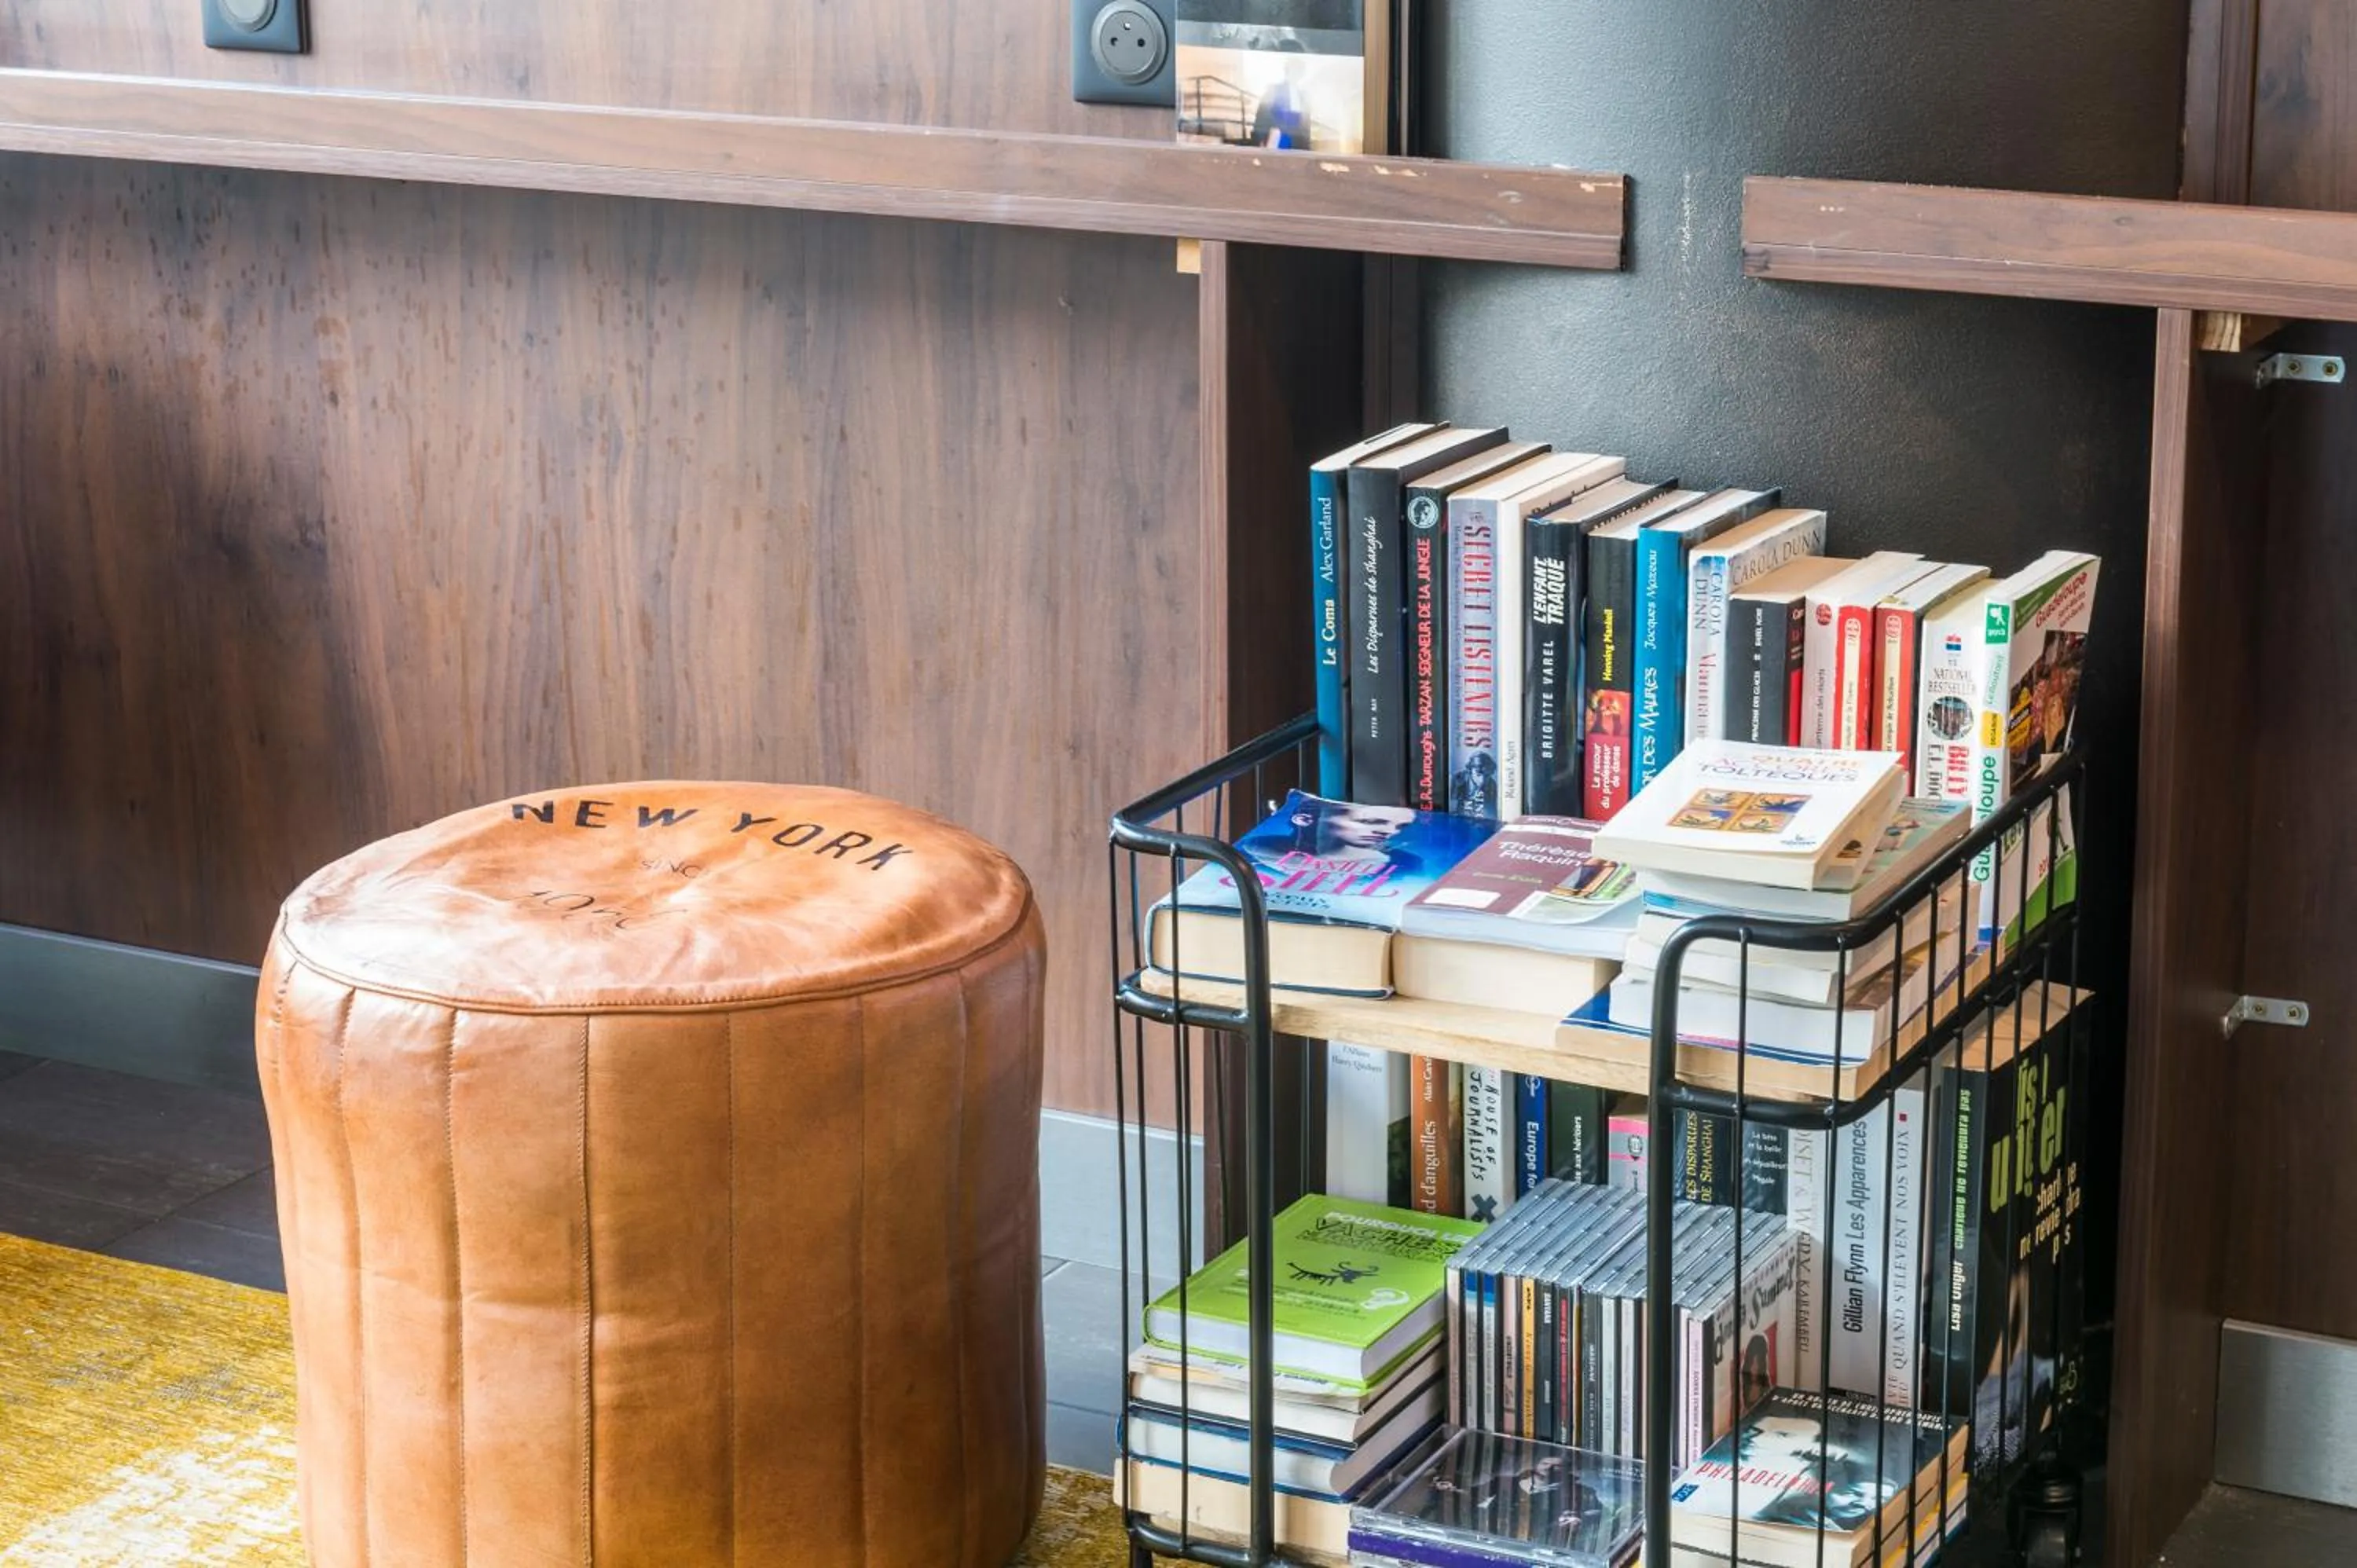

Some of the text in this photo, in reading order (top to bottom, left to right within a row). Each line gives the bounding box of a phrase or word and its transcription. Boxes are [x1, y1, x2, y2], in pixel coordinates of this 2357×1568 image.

[1318, 496, 1334, 582] Alex Garland
[1417, 537, 1431, 582] JUNGLE
[1732, 529, 1821, 586] CAROLA DUNN
[1362, 515, 1384, 674] Les Disparues de Shanghai
[1417, 584, 1431, 602] LA
[1463, 526, 1492, 615] SECRET
[1533, 555, 1548, 625] L'ENFANT
[1418, 602, 1431, 617] DE
[1644, 602, 1658, 650] Jacques
[1694, 578, 1708, 630] DUNN
[1710, 571, 1724, 636] CAROLA
[1322, 647, 1336, 665] Le
[1418, 621, 1432, 677] SEIGNEUR
[1933, 667, 1972, 681] NATIONAL
[1419, 680, 1433, 727] TARZAN
[1463, 625, 1493, 749] LISTENERS
[1542, 640, 1556, 759] BRIGITTE VAREL
[1637, 666, 1661, 732] MAURES
[1928, 680, 1978, 695] BESTSELLER
[1642, 735, 1656, 765] DES
[1947, 745, 1970, 795] BILLY
[1601, 743, 1613, 809] du professeur
[1611, 775, 1621, 788] de
[511, 800, 915, 872] NEW YORK
[1974, 755, 2000, 882] Gualoupe
[1497, 841, 1592, 859] Thérèse
[1498, 850, 1582, 867] Raquin
[1484, 1085, 1500, 1136] HOUSE
[1959, 1089, 1972, 1112] pas
[1420, 1119, 1439, 1196] d'anguilles
[1485, 1146, 1497, 1166] OF
[1524, 1121, 1540, 1171] Europe
[1685, 1111, 1698, 1200] LES DISPARUES
[1699, 1119, 1714, 1203] DE SHANGHAI
[1896, 1130, 1910, 1171] VOIX
[1896, 1175, 1909, 1210] NOS
[2034, 1186, 2081, 1247] reviedra
[1315, 1218, 1460, 1255] VACHES
[1324, 1211, 1438, 1239] POURQUOI
[1842, 1121, 1870, 1333] Gillian Flynn Les Apparences
[1891, 1309, 1908, 1370] QUAND
